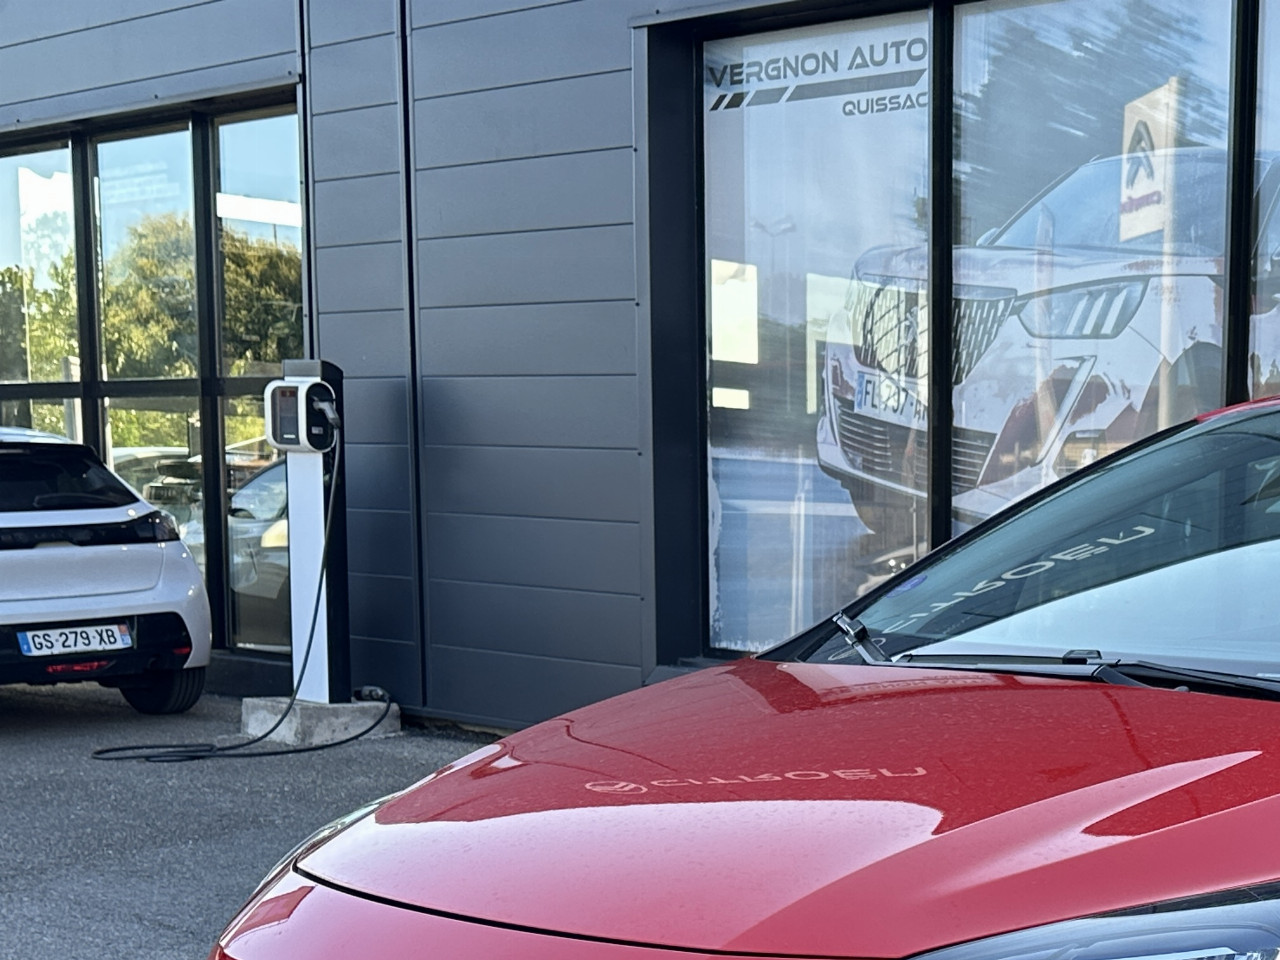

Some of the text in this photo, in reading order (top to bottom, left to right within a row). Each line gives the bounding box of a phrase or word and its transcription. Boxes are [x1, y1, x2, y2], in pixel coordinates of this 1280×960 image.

[708, 37, 928, 88] VERGNON AUTO
[842, 92, 929, 116] QUISSAC
